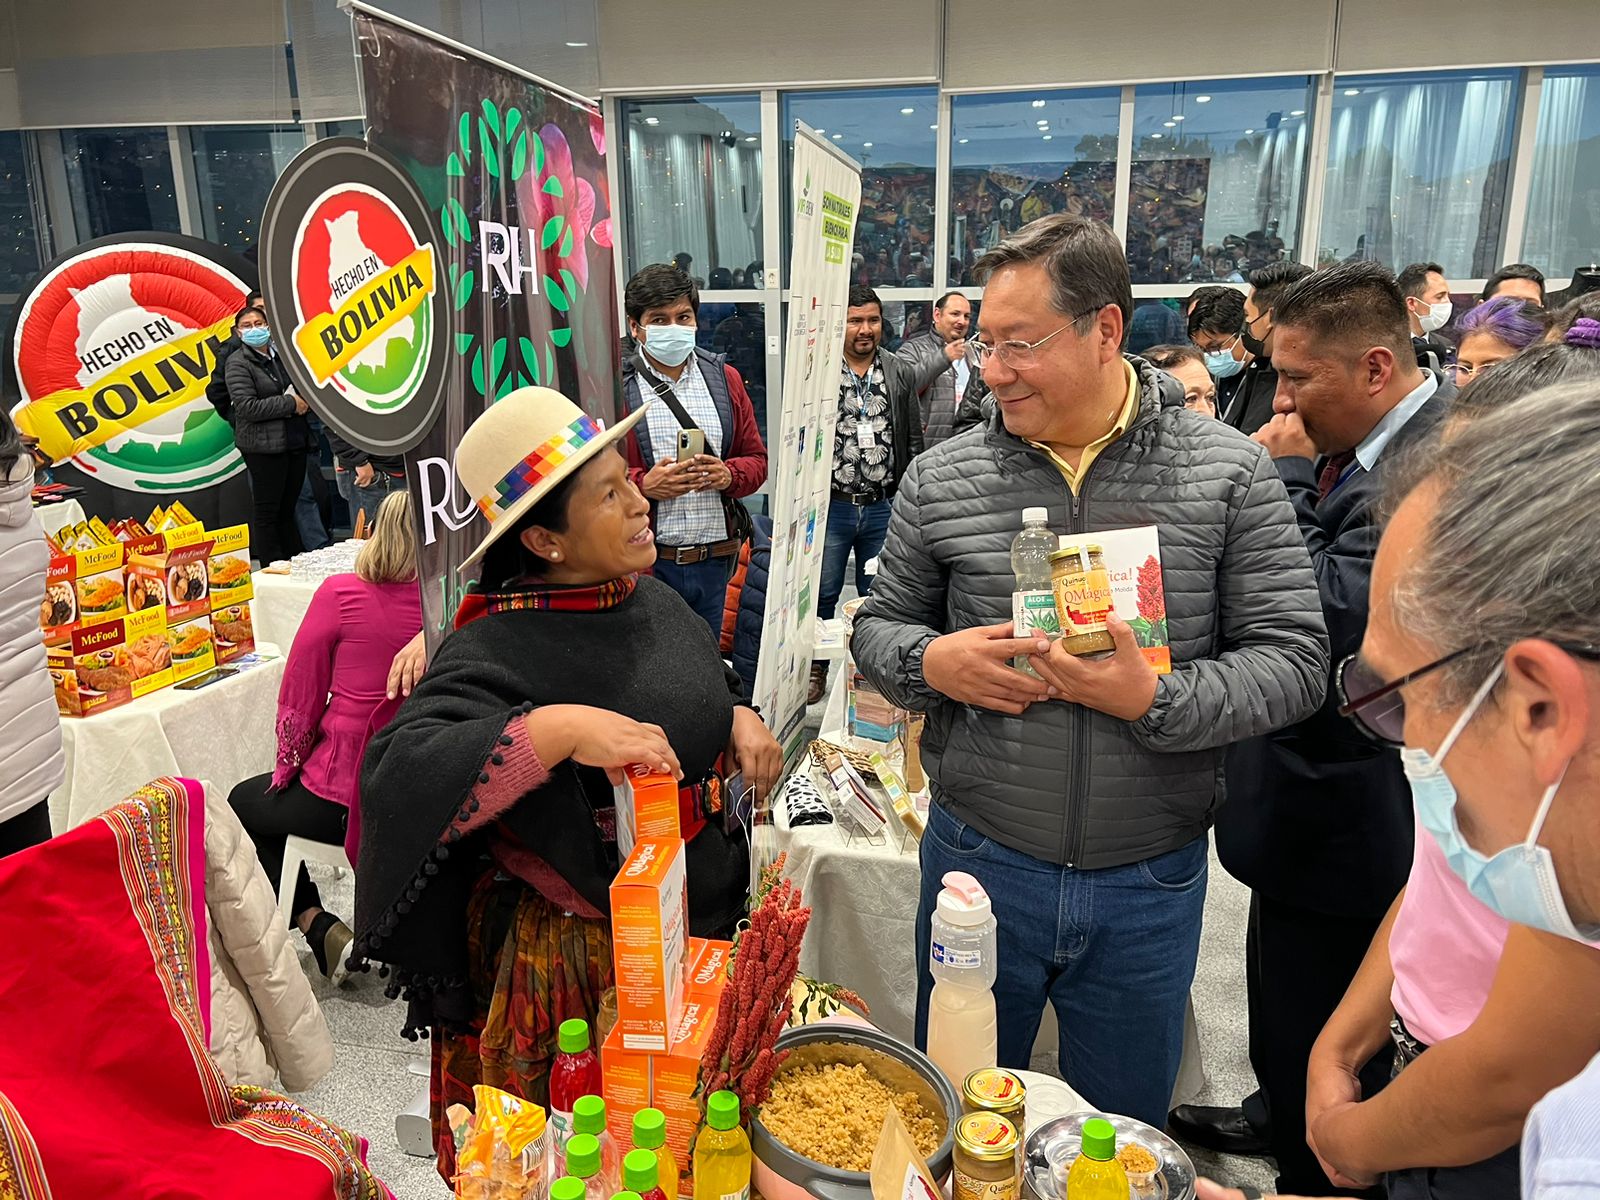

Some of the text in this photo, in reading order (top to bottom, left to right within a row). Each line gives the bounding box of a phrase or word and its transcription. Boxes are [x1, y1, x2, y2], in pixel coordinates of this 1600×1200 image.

[478, 219, 540, 295] RH
[331, 253, 380, 300] HECHO EN
[319, 264, 424, 361] BOLIVIA
[80, 317, 175, 375] HECHO EN
[55, 334, 222, 441] BOLIV
[172, 528, 199, 541] McFood
[212, 530, 243, 544] McFood
[84, 550, 117, 565] McFood
[126, 541, 157, 556] McFood
[46, 563, 69, 577] Food
[128, 611, 160, 628] McFood
[81, 627, 119, 647] McFood
